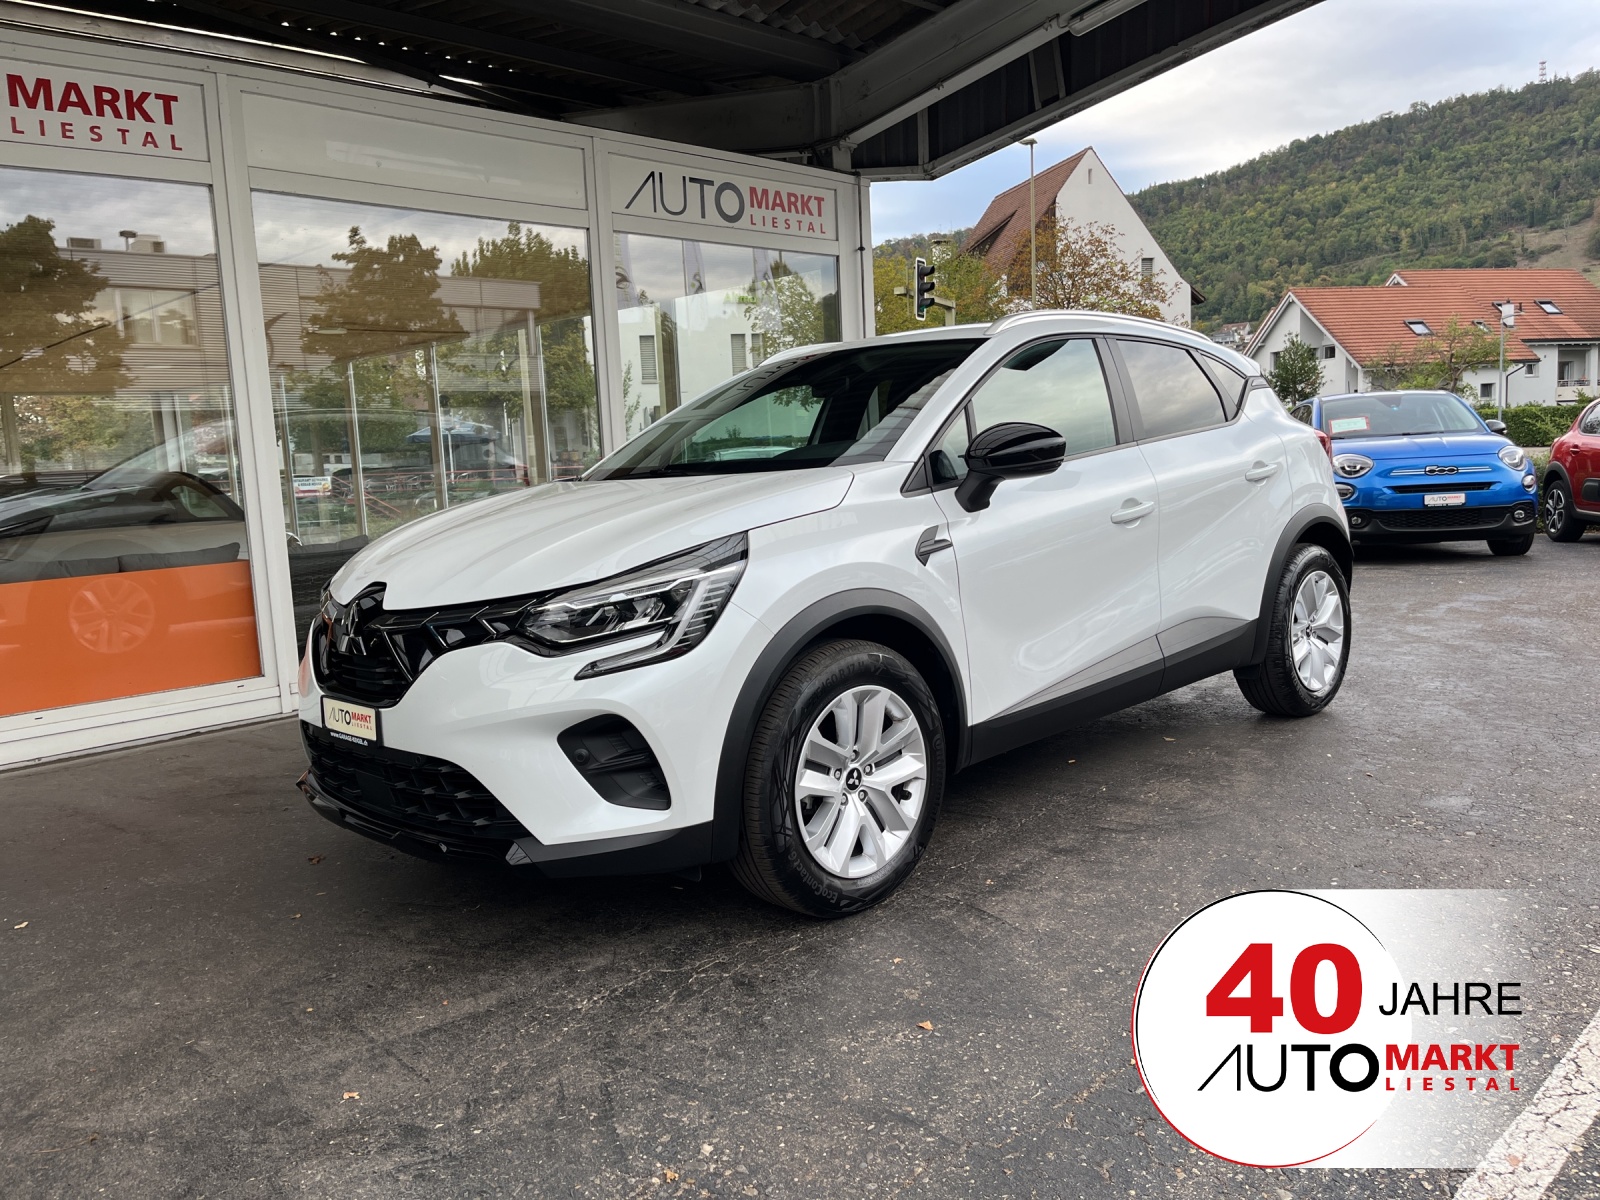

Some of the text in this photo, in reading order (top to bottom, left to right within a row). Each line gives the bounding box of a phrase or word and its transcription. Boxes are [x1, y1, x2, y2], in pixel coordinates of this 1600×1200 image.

[6, 73, 179, 126] MARKT
[10, 116, 183, 151] LIESTAL
[749, 186, 825, 218] MARKT
[750, 213, 826, 235] LIESTAL
[1425, 465, 1458, 475] 500
[351, 712, 371, 724] MARKT
